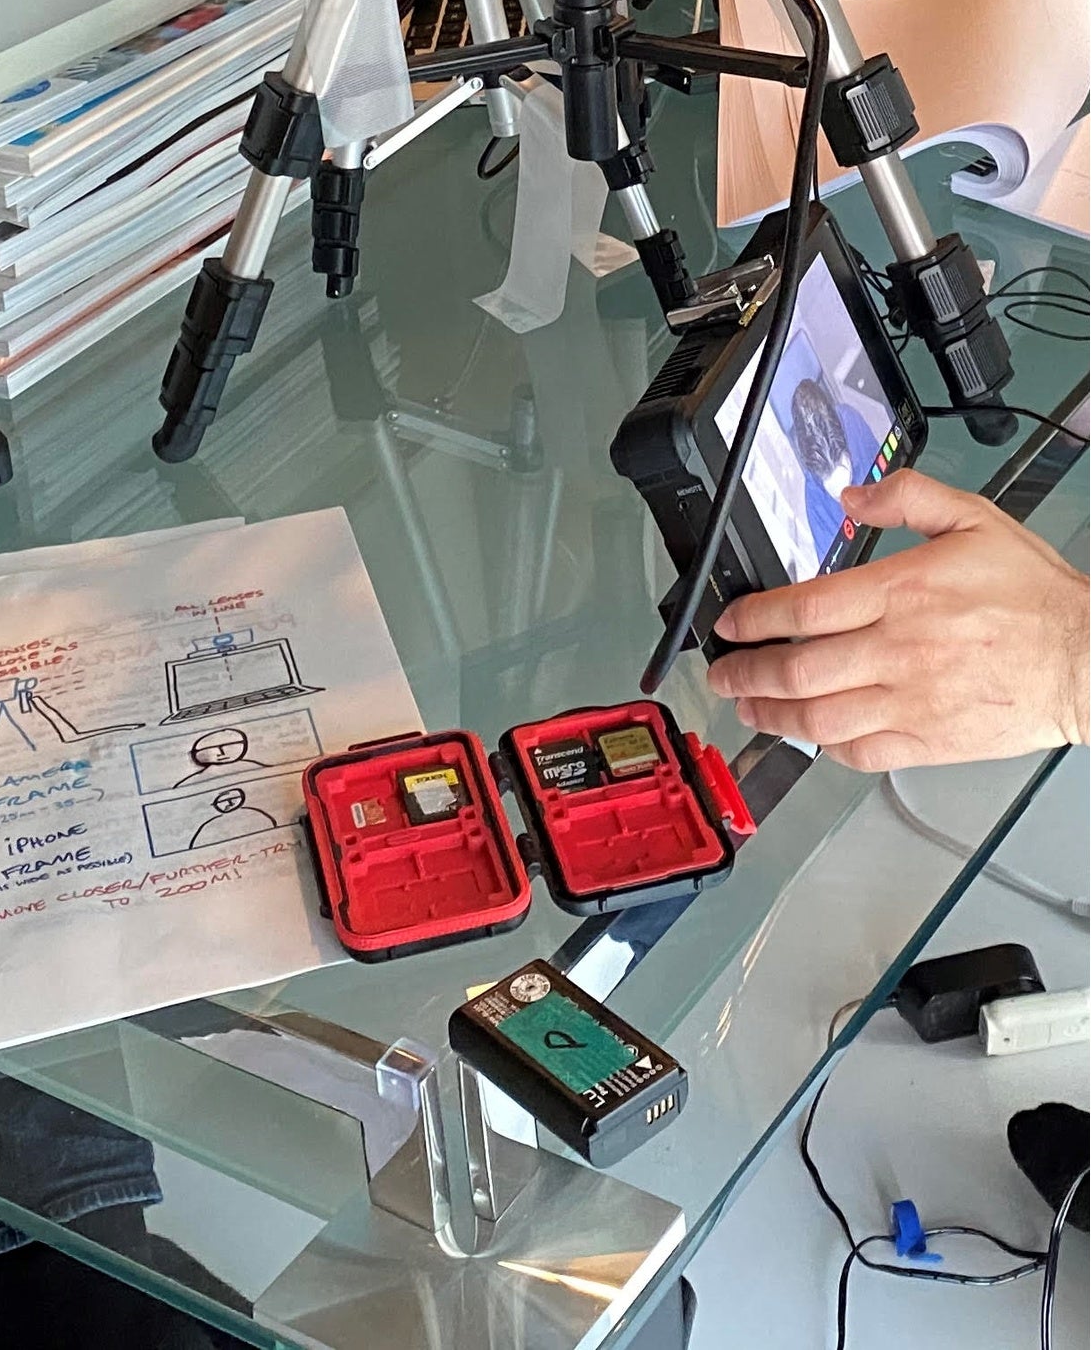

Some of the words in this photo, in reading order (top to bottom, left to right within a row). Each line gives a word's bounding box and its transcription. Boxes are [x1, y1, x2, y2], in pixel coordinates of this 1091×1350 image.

[53, 641, 79, 654] AS
[535, 746, 584, 766] Transcend
[0, 845, 92, 881] FRAME
[102, 896, 130, 910] TO
